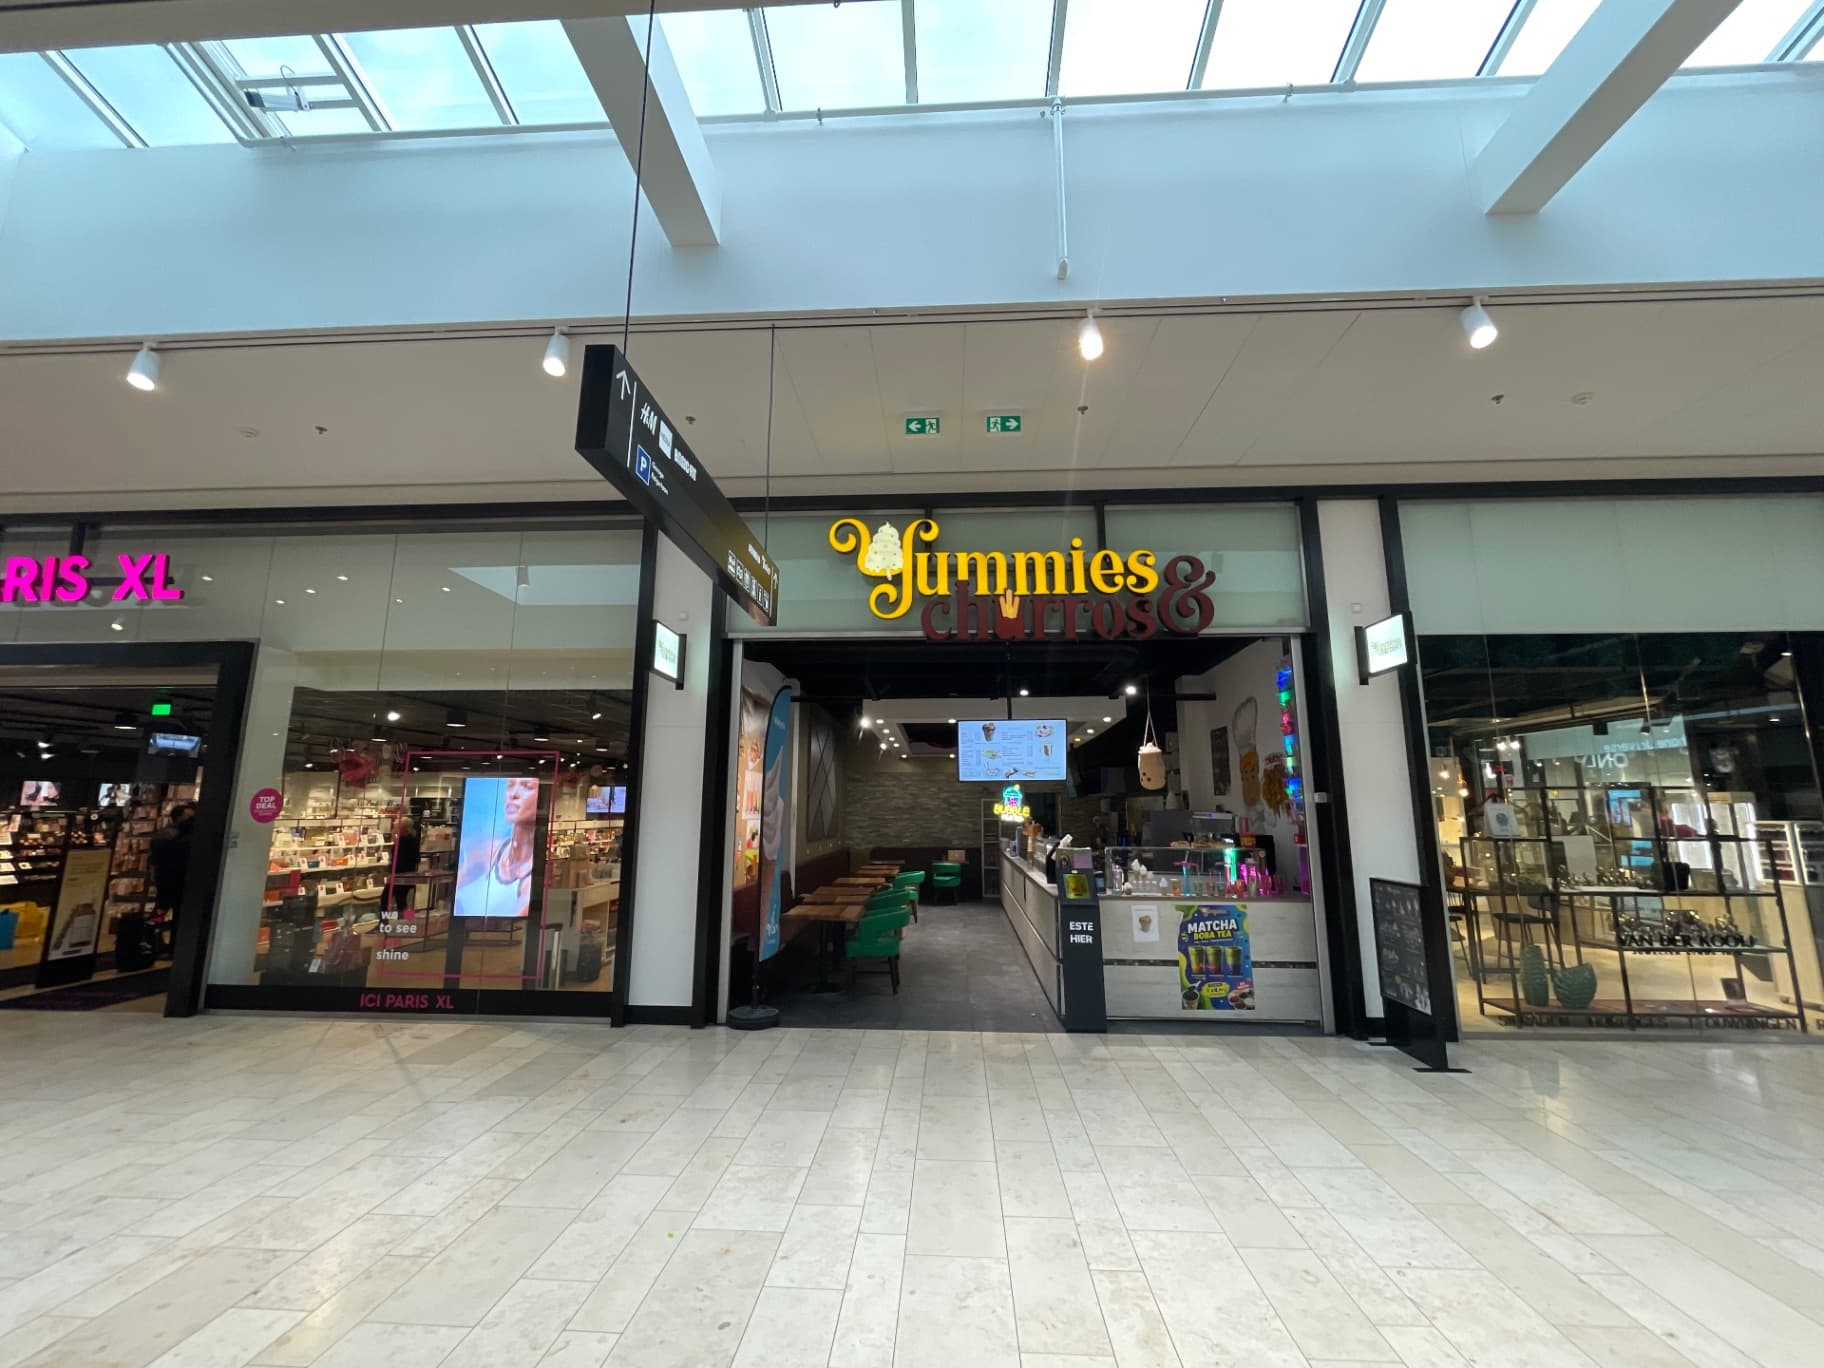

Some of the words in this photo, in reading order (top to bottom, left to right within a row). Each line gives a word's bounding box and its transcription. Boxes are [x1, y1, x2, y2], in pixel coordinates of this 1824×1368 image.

[640, 455, 648, 472] P
[111, 552, 184, 601] XL
[828, 517, 1159, 621] Yummies
[1158, 555, 1216, 635] &
[921, 577, 1158, 642] churros
[380, 922, 392, 933] to
[396, 923, 417, 934] see
[1187, 918, 1238, 934] MATCHA
[1070, 934, 1093, 944] HIER
[1193, 931, 1215, 941] BOBA
[1217, 929, 1233, 938] TEA
[1617, 933, 1653, 947] VAN
[1659, 933, 1693, 947] DER
[376, 949, 409, 960] shine
[360, 993, 381, 1008] ICI
[385, 994, 429, 1009] PARIS
[435, 995, 454, 1009] XL
